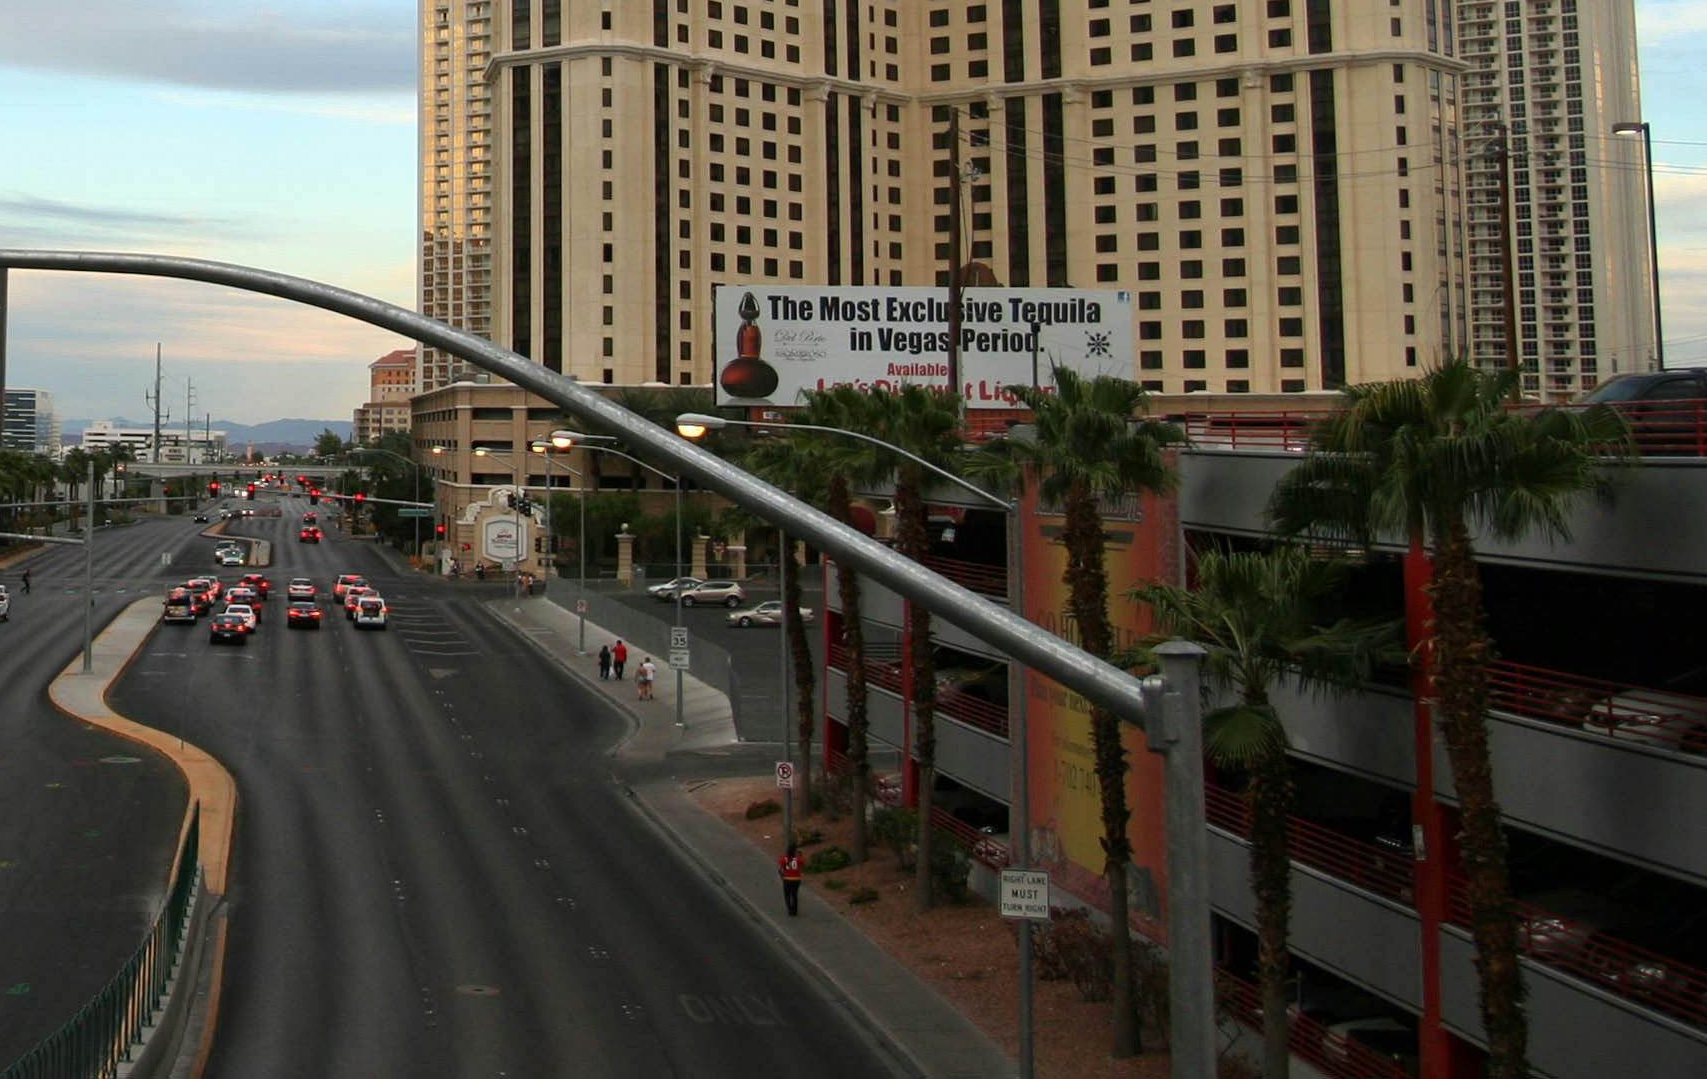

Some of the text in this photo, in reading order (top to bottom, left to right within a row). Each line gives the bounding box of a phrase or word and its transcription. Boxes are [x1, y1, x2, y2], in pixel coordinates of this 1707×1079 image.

[767, 295, 813, 321] The
[819, 296, 881, 322] Most
[1009, 297, 1101, 326] Tequila
[850, 327, 872, 351] in
[878, 328, 950, 355] Vegas
[887, 362, 948, 376] Available
[673, 637, 686, 646] 35
[1003, 875, 1047, 885] RIGHT LANE
[1011, 888, 1039, 899] MUST
[1003, 903, 1047, 912] TURN RIGHT
[678, 993, 791, 1027] ONLY
